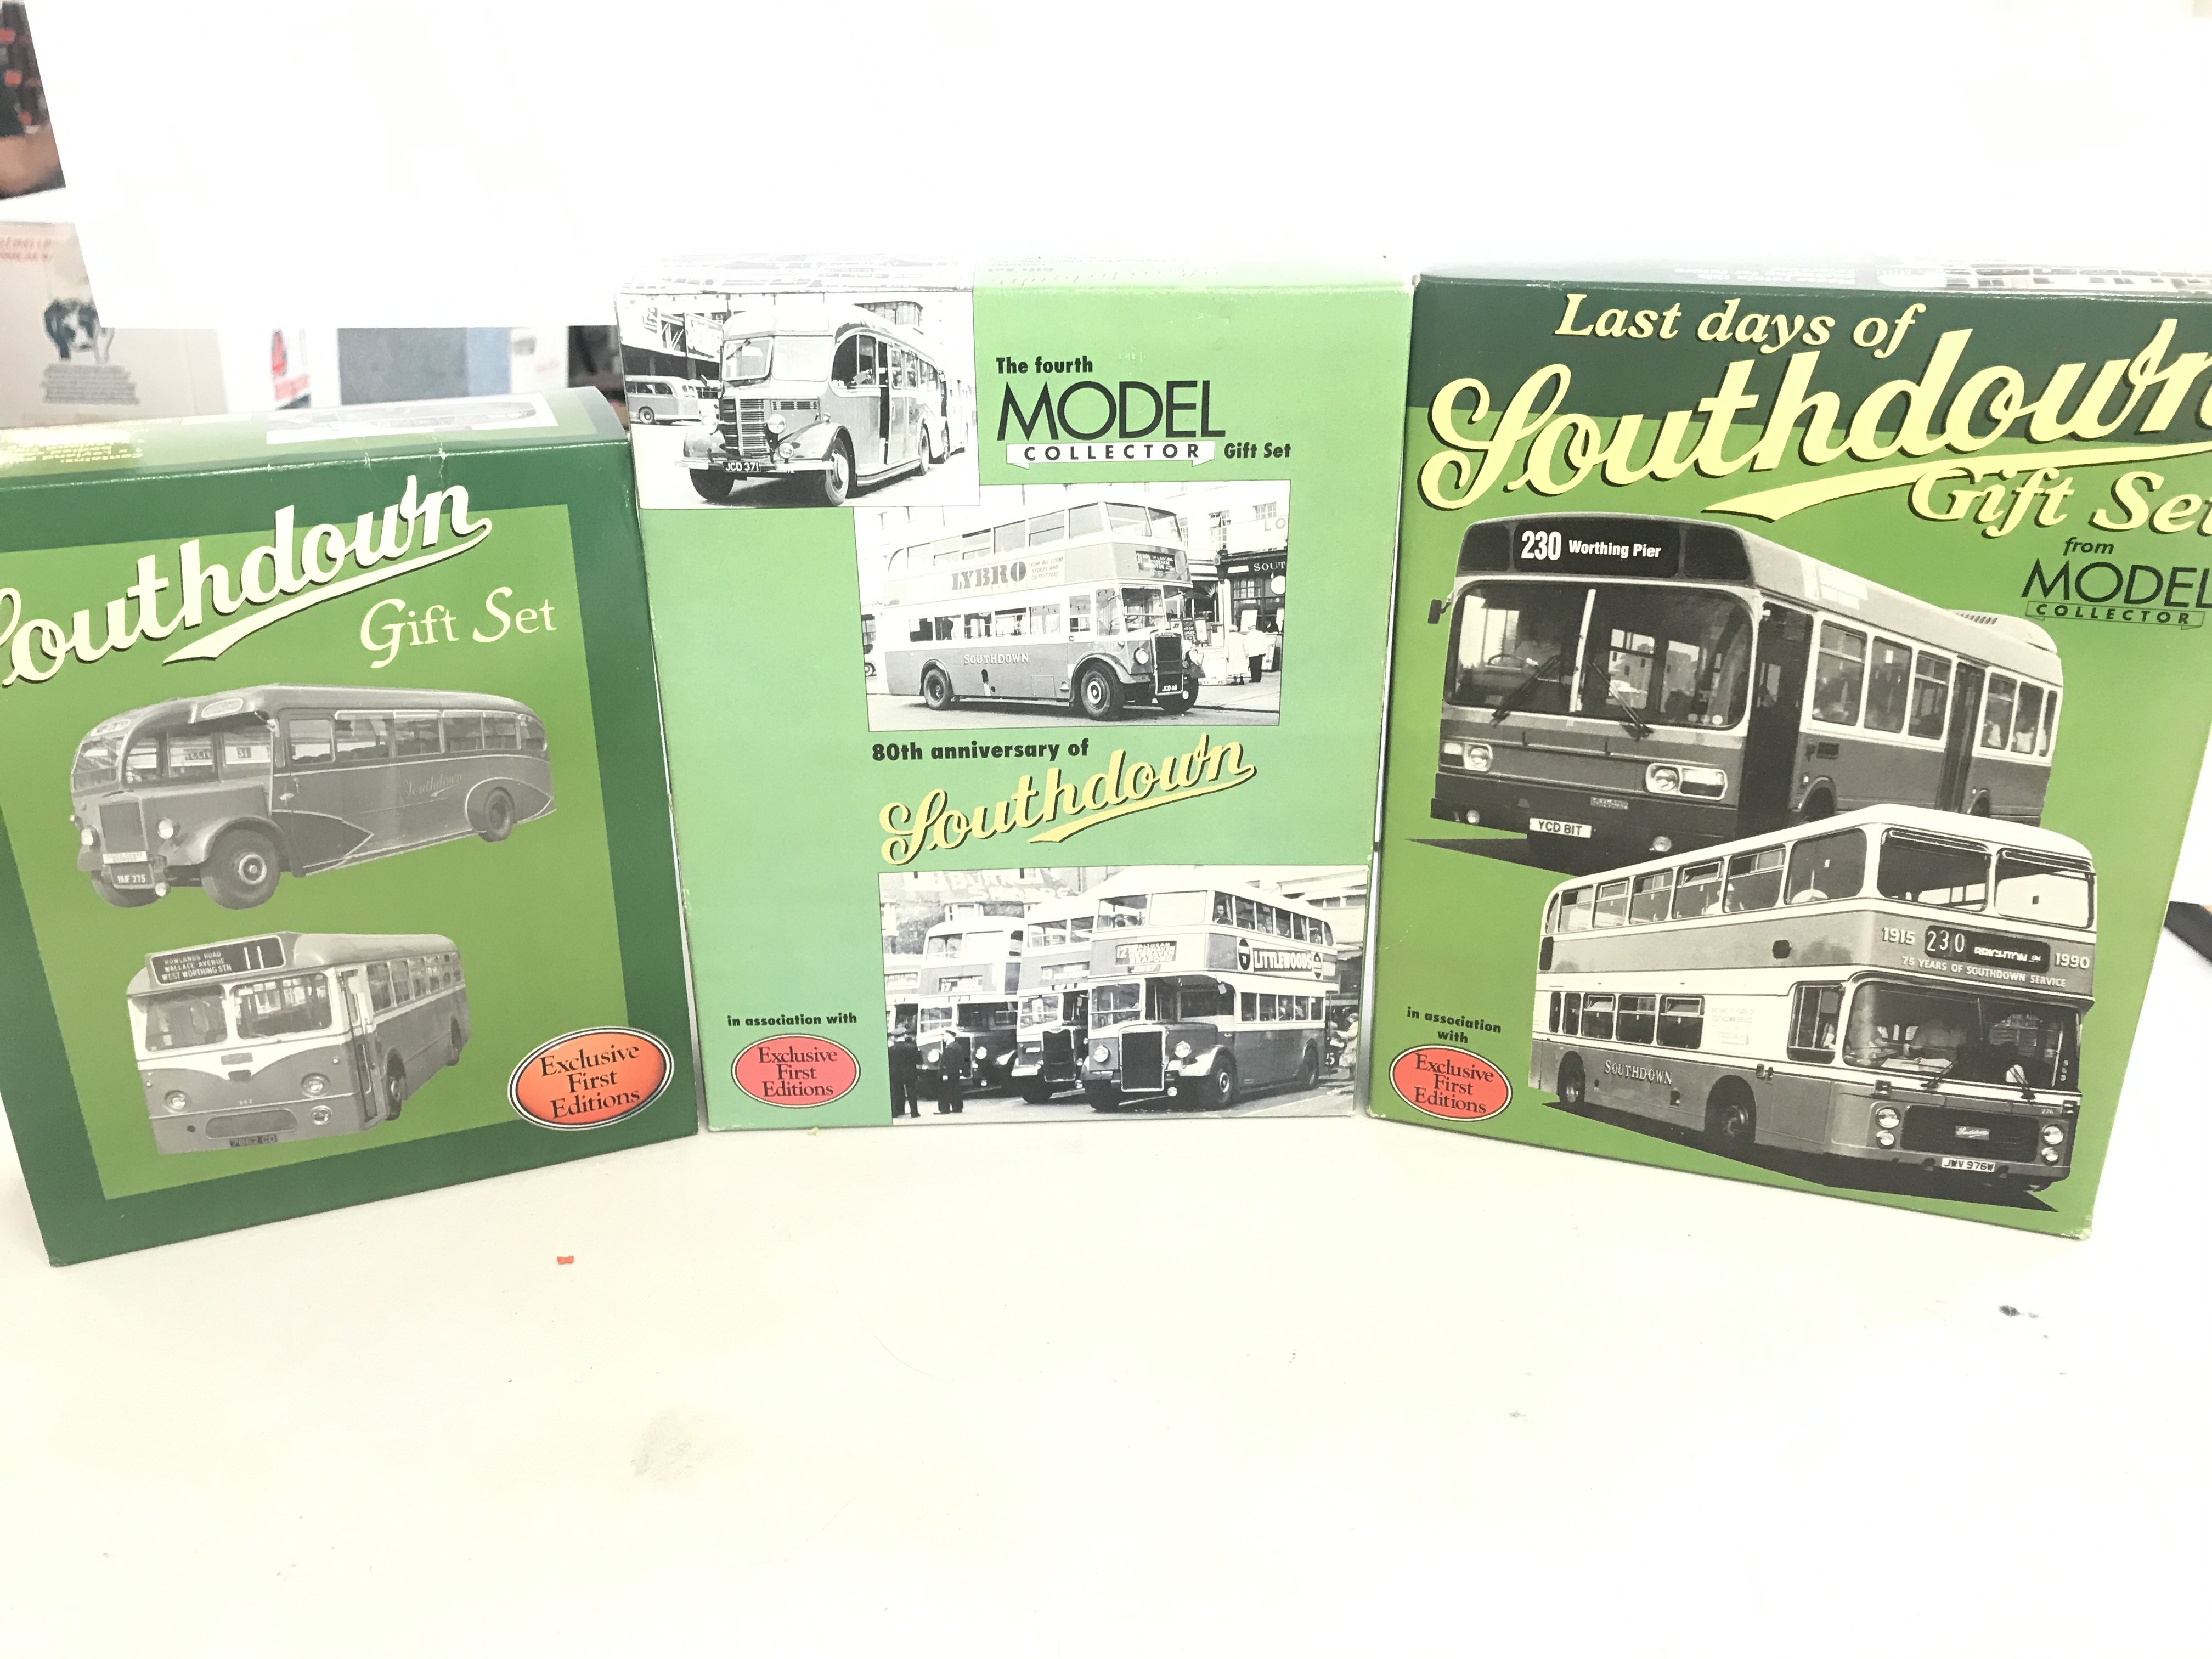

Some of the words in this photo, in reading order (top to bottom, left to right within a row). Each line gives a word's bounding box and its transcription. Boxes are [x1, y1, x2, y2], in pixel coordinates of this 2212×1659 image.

[1555, 294, 1681, 340] Last
[1697, 297, 1837, 356] days
[1851, 303, 1927, 360] of
[996, 357, 1028, 374] The
[1035, 355, 1093, 374] fourth
[996, 379, 1226, 442] MODEL
[1024, 443, 1199, 461] COLLECTOR
[1224, 442, 1257, 459] Gift
[1264, 442, 1292, 459] Set
[725, 462, 742, 471] JCD
[744, 462, 759, 472] 371
[1908, 467, 2074, 539] Gift
[1521, 530, 1562, 561] 230
[1569, 540, 1629, 559] Worthing
[1633, 543, 1662, 558] Pier
[2062, 536, 2114, 556] from
[951, 561, 1026, 591] LYBRO
[2021, 557, 2212, 609] MODEL
[2036, 603, 2190, 624] COLLECTOR
[359, 597, 459, 669] Gift
[471, 586, 557, 644] Set
[964, 653, 1029, 665] SOUTHDOWN
[872, 742, 923, 761] 80th
[930, 740, 1059, 763] anniversary
[1067, 737, 1090, 758] of
[879, 733, 1257, 866] Southdown
[1538, 820, 1561, 833] YCD
[1563, 823, 1583, 837] 81T
[1253, 950, 1312, 969] LITTLEWOODS
[1882, 927, 1915, 945] 1915
[1927, 930, 1966, 953] 230
[2055, 952, 2090, 970] 1990
[182, 966, 217, 979] WORTHING
[1901, 956, 1915, 966] 75
[1918, 958, 1948, 971] YEARS
[1951, 964, 1963, 973] OF
[1966, 966, 2025, 983] SOUTHDOWN
[2030, 974, 2067, 988] SERVICE
[727, 1015, 741, 1027] in
[745, 1014, 822, 1026] association
[826, 1012, 857, 1024] with
[1407, 1006, 1420, 1019] in
[1424, 1012, 1502, 1033] association
[1437, 1030, 1468, 1043] with
[538, 1044, 641, 1077] Exclusive
[758, 1046, 838, 1064] Exclusive
[776, 1063, 818, 1080] First
[1415, 1053, 1494, 1082] Exclusive
[1604, 1059, 1673, 1085] SOUTHDOWN
[566, 1070, 618, 1094] First
[761, 1080, 834, 1097] Editions
[1434, 1073, 1474, 1096] First
[550, 1090, 641, 1119] Editions
[1414, 1086, 1487, 1114] Editions
[1944, 1159, 1965, 1168] JWV
[1967, 1161, 1994, 1171] 976W
